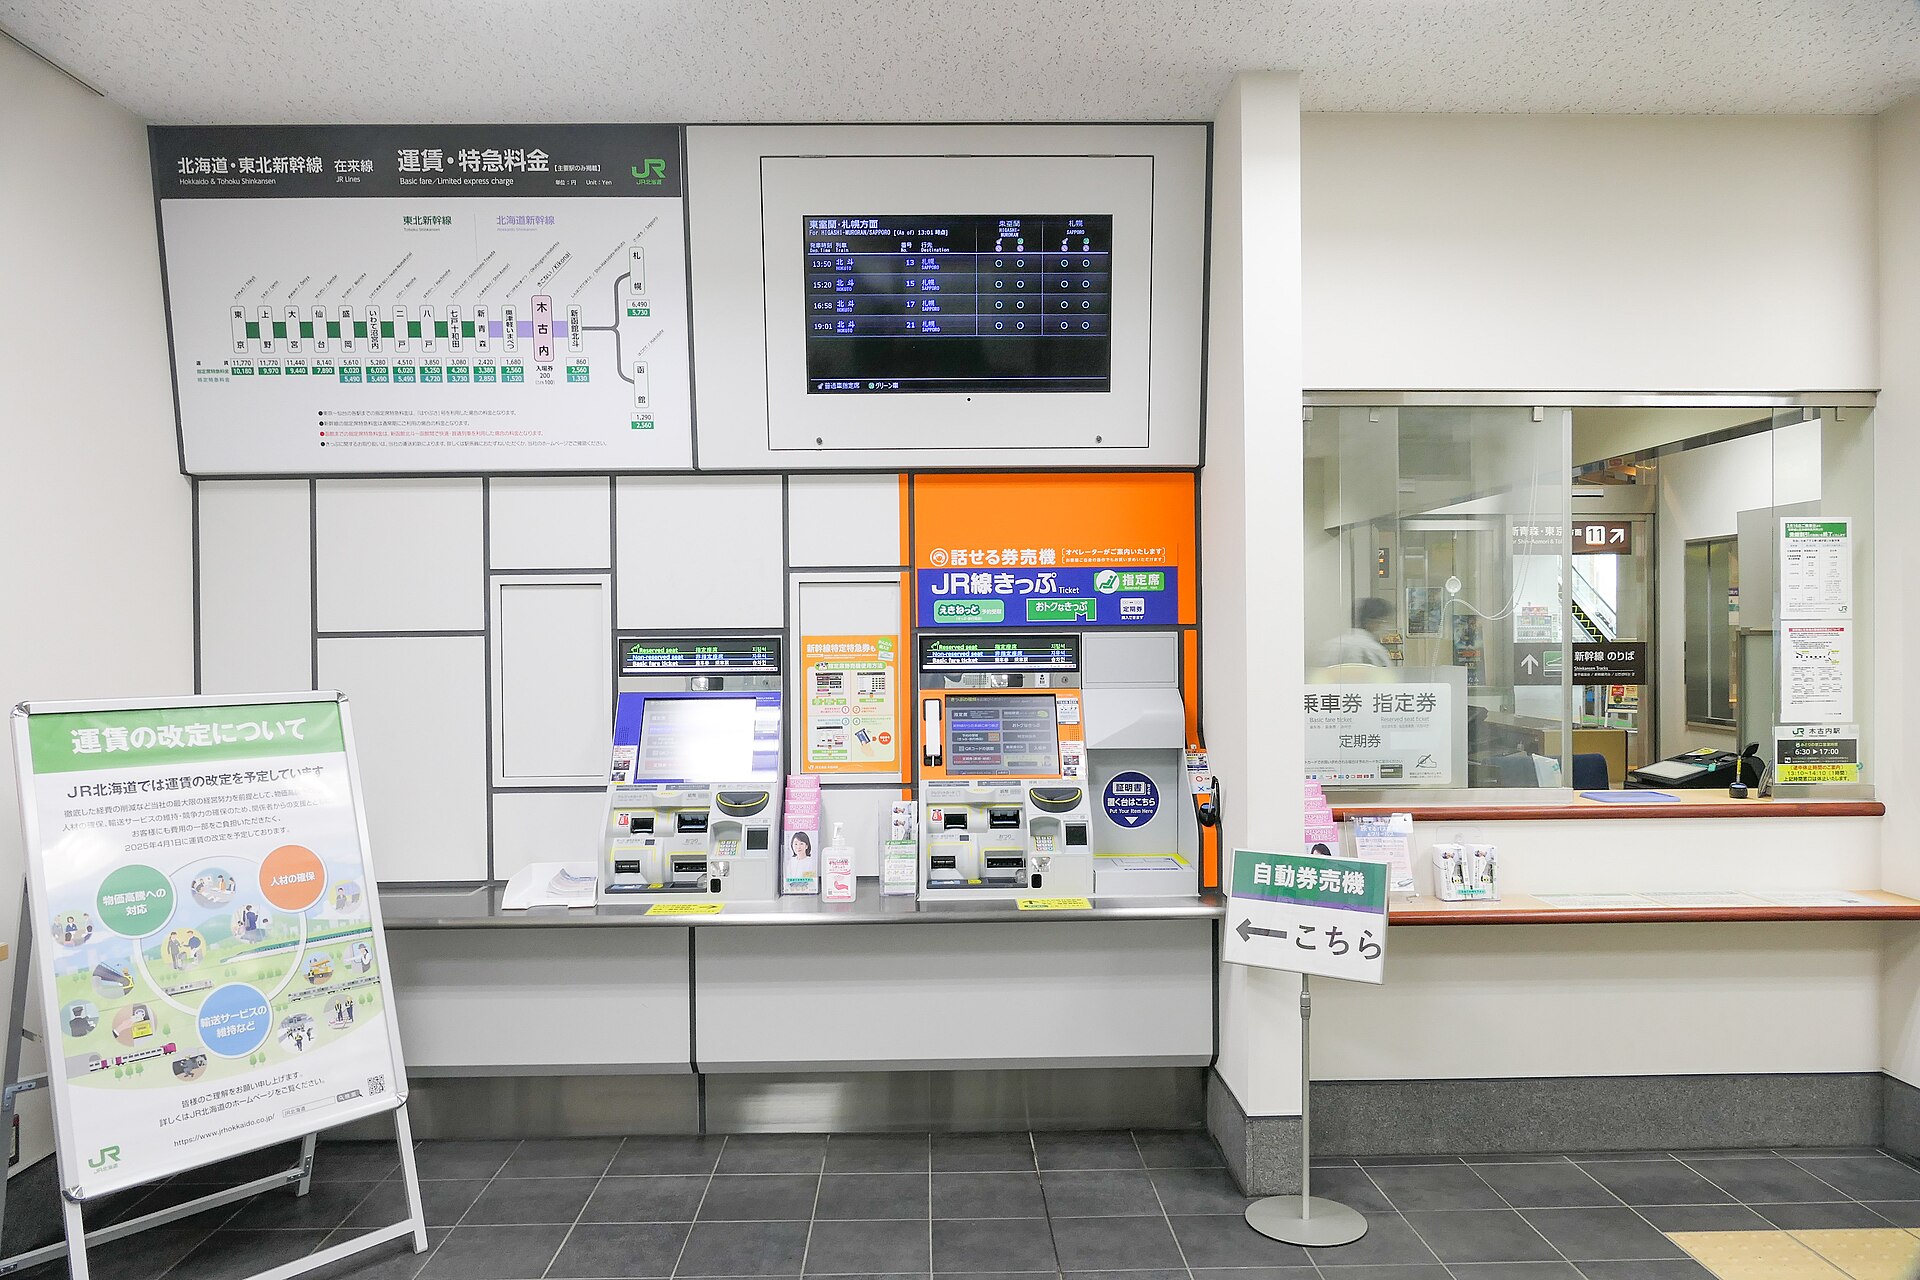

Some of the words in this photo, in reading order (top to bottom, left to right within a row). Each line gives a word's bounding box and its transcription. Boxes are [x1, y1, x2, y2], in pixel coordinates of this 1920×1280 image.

[178, 156, 323, 175] 北海道・東北新幹線
[334, 160, 374, 173] 在来線
[398, 149, 549, 173] 運賃・特急料金
[631, 159, 666, 178] JR
[179, 177, 209, 185] Hokkaido
[217, 177, 240, 185] Tohoku
[241, 177, 276, 185] Shinkansen
[400, 177, 417, 185] Basic
[463, 178, 489, 186] express
[491, 177, 514, 186] charge
[403, 215, 452, 225] 東北新幹線
[497, 215, 555, 225] 北海道新幹線
[552, 250, 573, 270] Kikonai
[633, 251, 642, 290] 札幌
[234, 310, 245, 349] 東京
[261, 310, 272, 349] 上野
[288, 310, 299, 349] 大宮
[315, 310, 325, 349] 仙台
[342, 310, 352, 348] 盛岡
[396, 310, 406, 348] 二戸
[423, 310, 433, 348] 八戸
[450, 309, 460, 348] 七戸十和田
[478, 309, 487, 347] 新青森
[536, 302, 549, 357] 木古内
[637, 366, 646, 404] 函館
[1588, 528, 1602, 542] 11
[951, 548, 1056, 566] 話せる券売機
[931, 572, 1057, 595] JR線きっぷ
[1059, 586, 1080, 594] Ticket
[1122, 574, 1160, 586] 指定席
[938, 604, 980, 616] えきねっと
[1035, 602, 1088, 611] おトクなきっぷ
[1122, 605, 1143, 613] 定期券
[1574, 651, 1605, 661] 新幹線
[1607, 651, 1635, 661] のりば
[1304, 693, 1363, 714] 乗車券
[1373, 692, 1436, 713] 指定券
[71, 717, 307, 755] 運賃の改定について
[1339, 734, 1381, 748] 定期券
[1116, 784, 1142, 792] 証明書
[1107, 798, 1156, 806] 置く台はこちら
[131, 816, 282, 838] お客様にも費用の一部をご負担いただきたく、
[124, 827, 290, 852] 2025年4月1日に運賃の改定を予定しております。
[270, 872, 316, 887] 人材の確保
[1253, 862, 1365, 896] 自動券売機
[102, 888, 166, 906] 物価高騰への
[125, 904, 148, 916] 対応
[1295, 924, 1382, 960] こちら
[200, 1005, 267, 1029] 輸送サービスの
[216, 1020, 256, 1040] 維持など
[181, 1071, 303, 1108] 皆様のご理解をお願い申し上げます。
[159, 1079, 326, 1128] 詳しくはJR北海道のホームページをご覧ください。
[173, 1113, 275, 1147] https://www.jrhokkaido.co.jp/
[88, 1145, 121, 1169] JR
[93, 1163, 119, 1174] JR北海道
